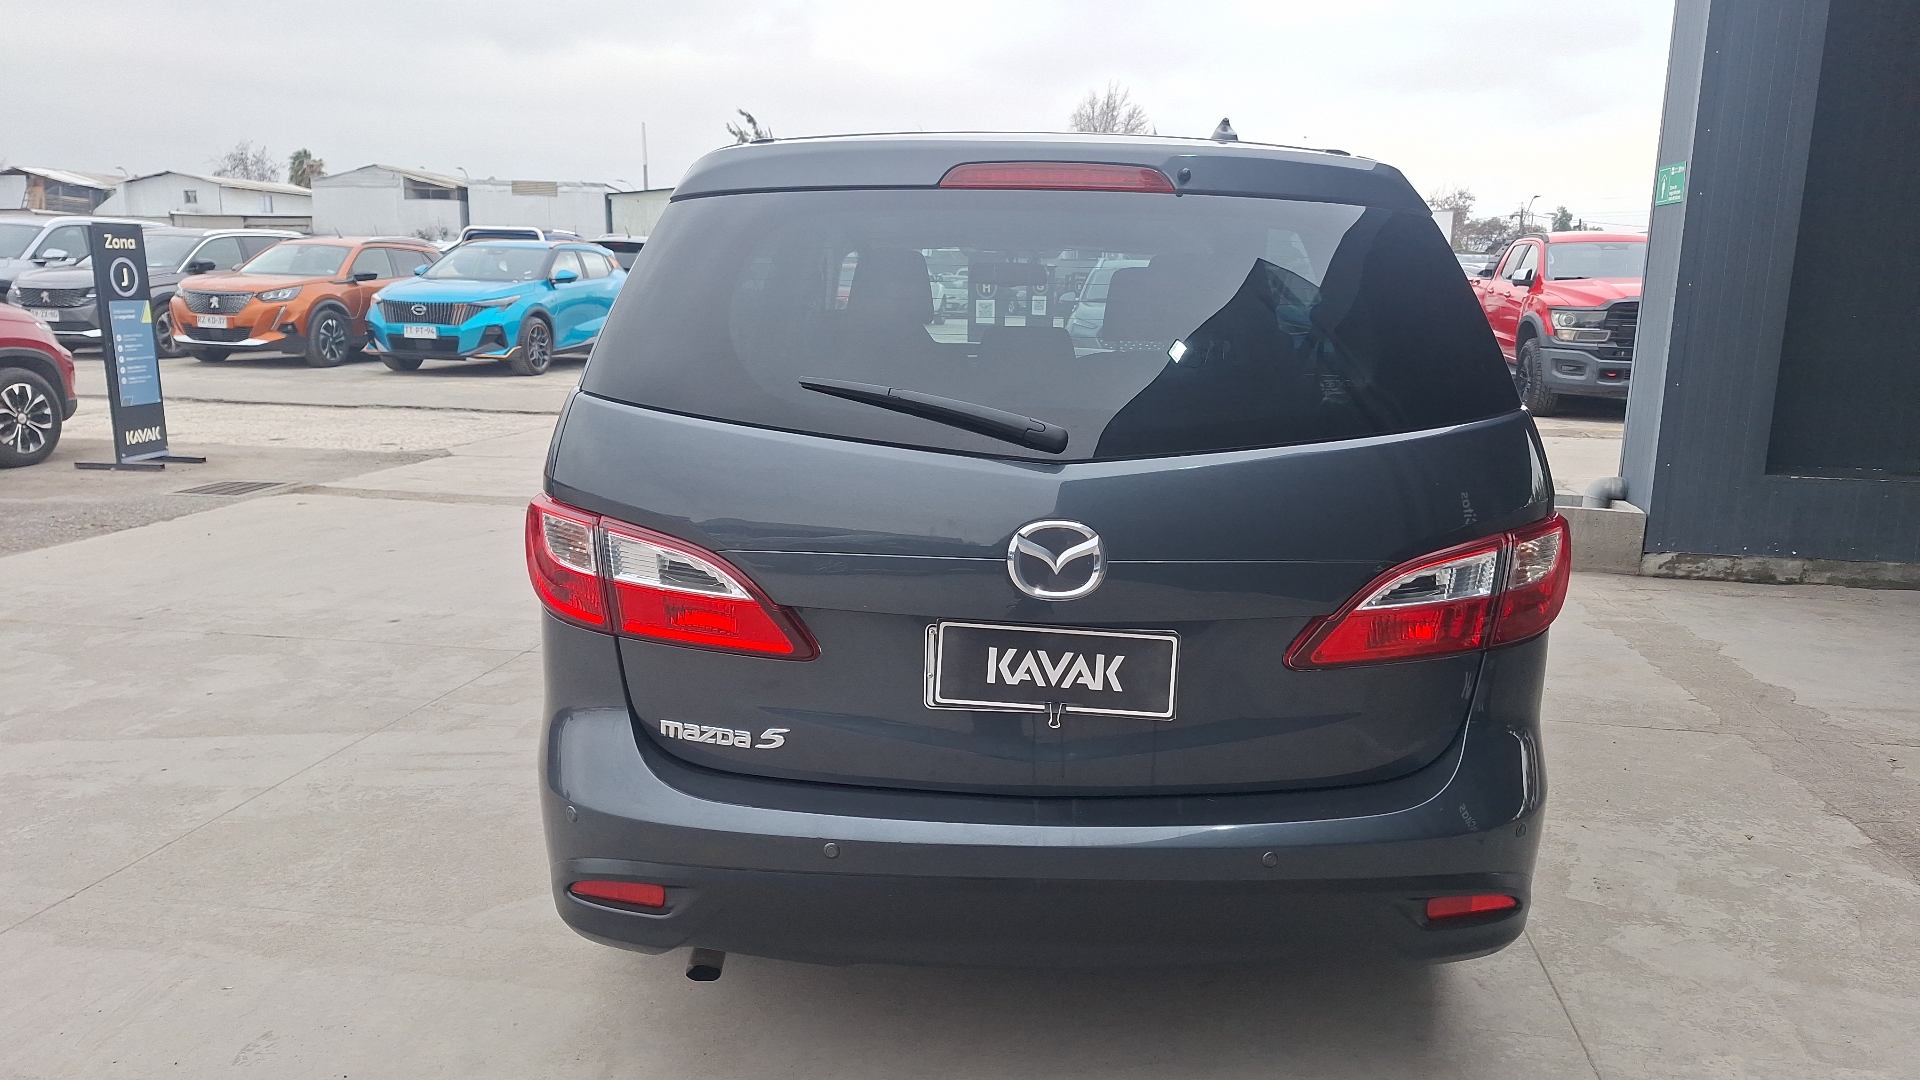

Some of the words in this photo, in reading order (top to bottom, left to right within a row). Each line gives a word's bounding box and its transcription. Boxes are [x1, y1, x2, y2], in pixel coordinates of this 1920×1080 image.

[103, 233, 136, 249] Zona
[121, 267, 129, 287] J
[983, 284, 991, 293] H
[126, 425, 161, 446] KAVAK
[986, 646, 1126, 692] KAVAK
[754, 728, 791, 749] 5
